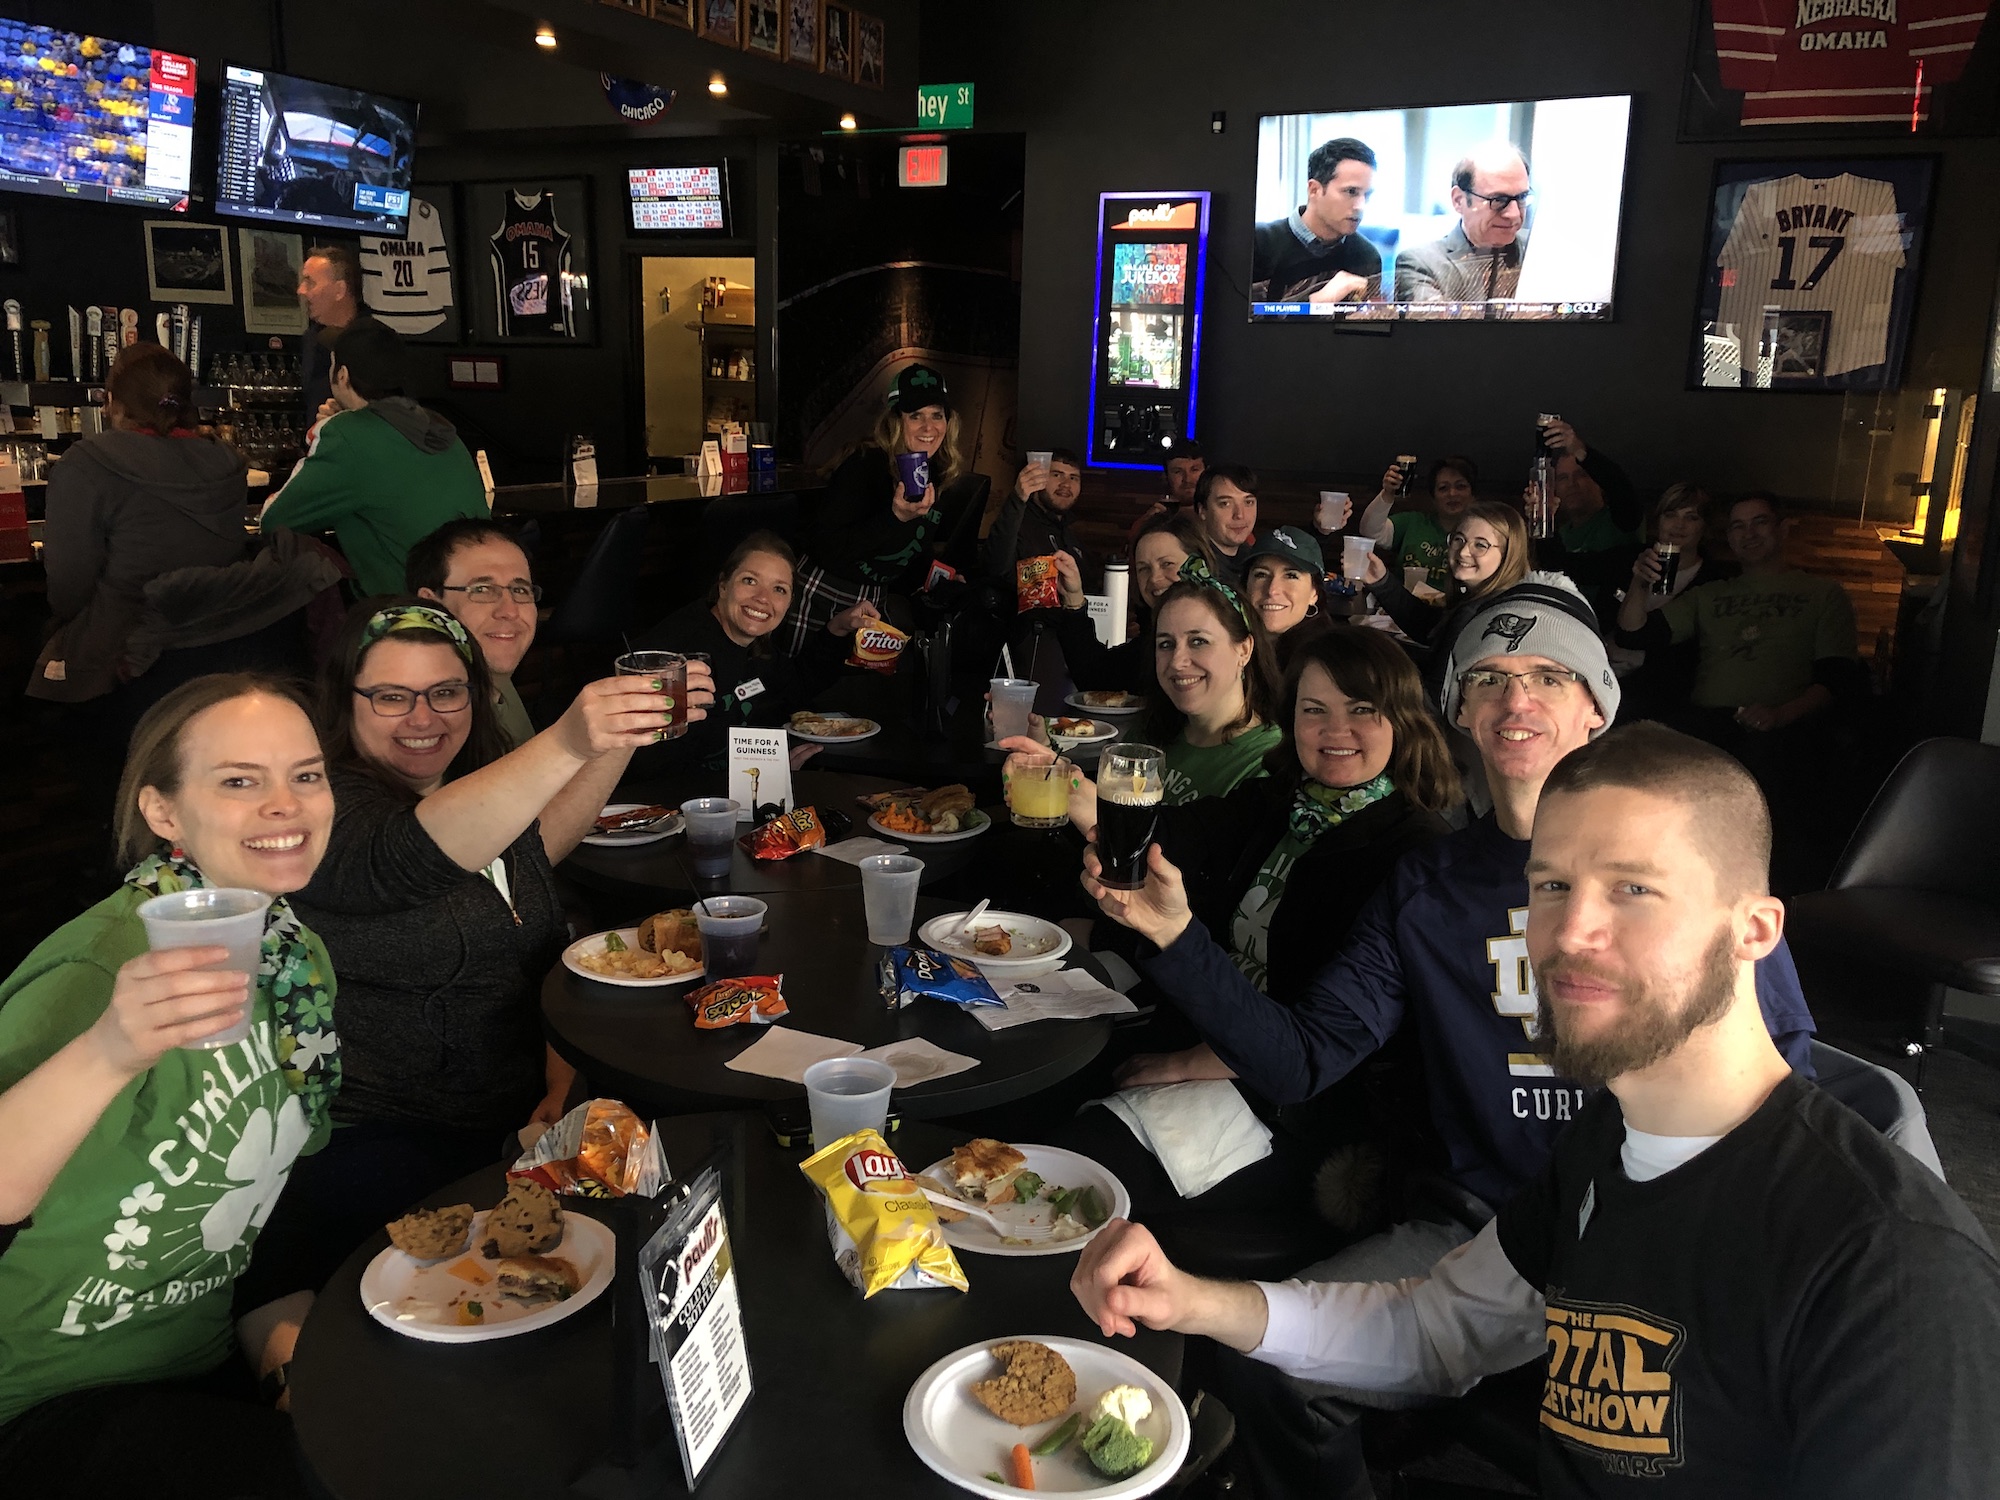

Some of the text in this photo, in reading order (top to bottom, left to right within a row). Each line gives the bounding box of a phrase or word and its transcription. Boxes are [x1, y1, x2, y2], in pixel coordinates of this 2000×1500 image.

[1794, 0, 1898, 30] NEBRASKA
[1800, 30, 1888, 51] OMAHA
[957, 87, 970, 105] St
[620, 98, 665, 120] CHICAGO
[906, 148, 942, 182] EXIT
[1776, 204, 1855, 234] BRYANT
[506, 221, 554, 242] OMAHA
[380, 240, 425, 256] OMAHA
[522, 241, 539, 268] 15
[393, 260, 414, 287] 20
[1770, 236, 1845, 290] 17
[1120, 270, 1178, 284] JUKEBOX
[1573, 303, 1603, 313] GOLF
[860, 630, 904, 650] Fritos
[736, 747, 777, 755] GUINNESS
[1112, 793, 1157, 806] GUINNESS
[148, 1020, 278, 1187] CURLIN
[884, 1200, 931, 1213] Classic
[72, 1276, 135, 1306] LIKE
[136, 1290, 158, 1311] A
[678, 1288, 701, 1326] COLD
[700, 1258, 720, 1288] BEER
[686, 1278, 720, 1332] BOTTLES
[1567, 1311, 1592, 1328] THE
[1600, 1452, 1666, 1478] WARS
